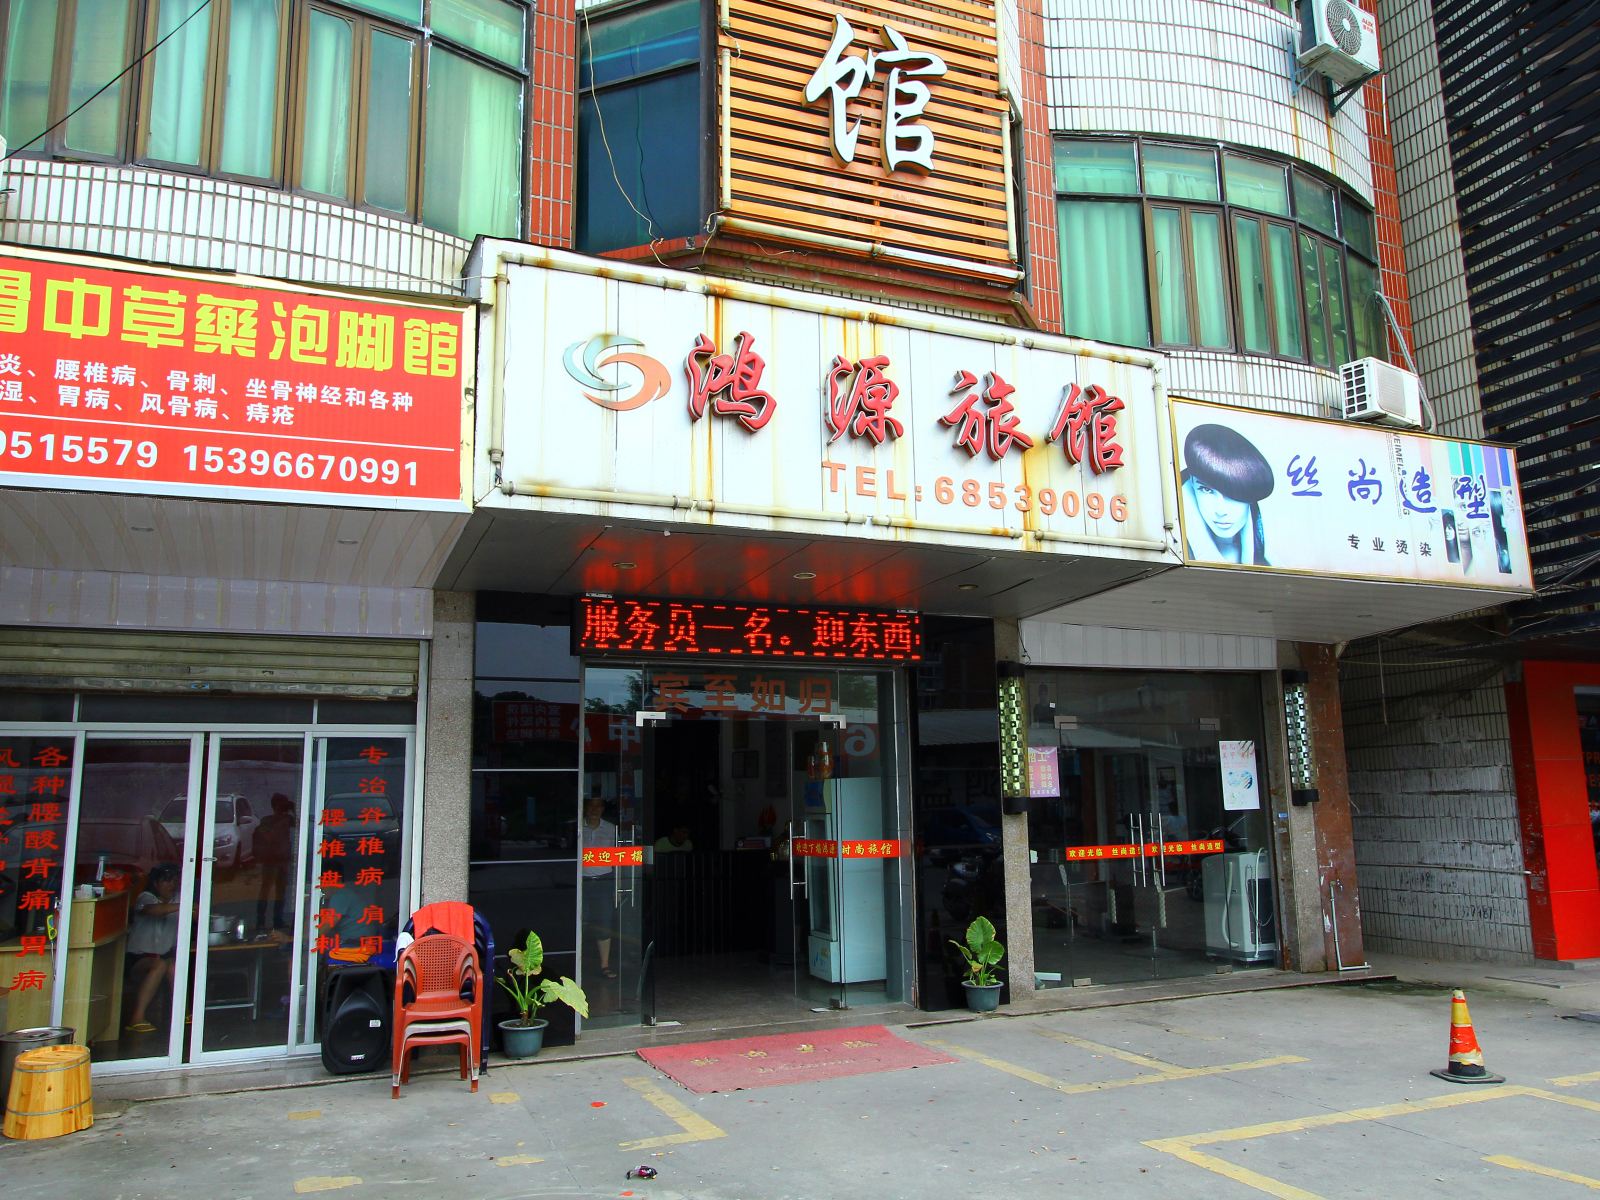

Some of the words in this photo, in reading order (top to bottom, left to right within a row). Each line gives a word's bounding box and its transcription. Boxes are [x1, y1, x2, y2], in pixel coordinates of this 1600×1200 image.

[802, 13, 947, 177] 馆
[683, 330, 1126, 475] 鸿源旅馆
[183, 445, 418, 486] 15396670991
[1286, 454, 1490, 519] 丝尚造型
[1347, 533, 1432, 557] 专业烫染
[652, 671, 832, 714] 宾至如归
[582, 849, 644, 863] 欢迎下榻
